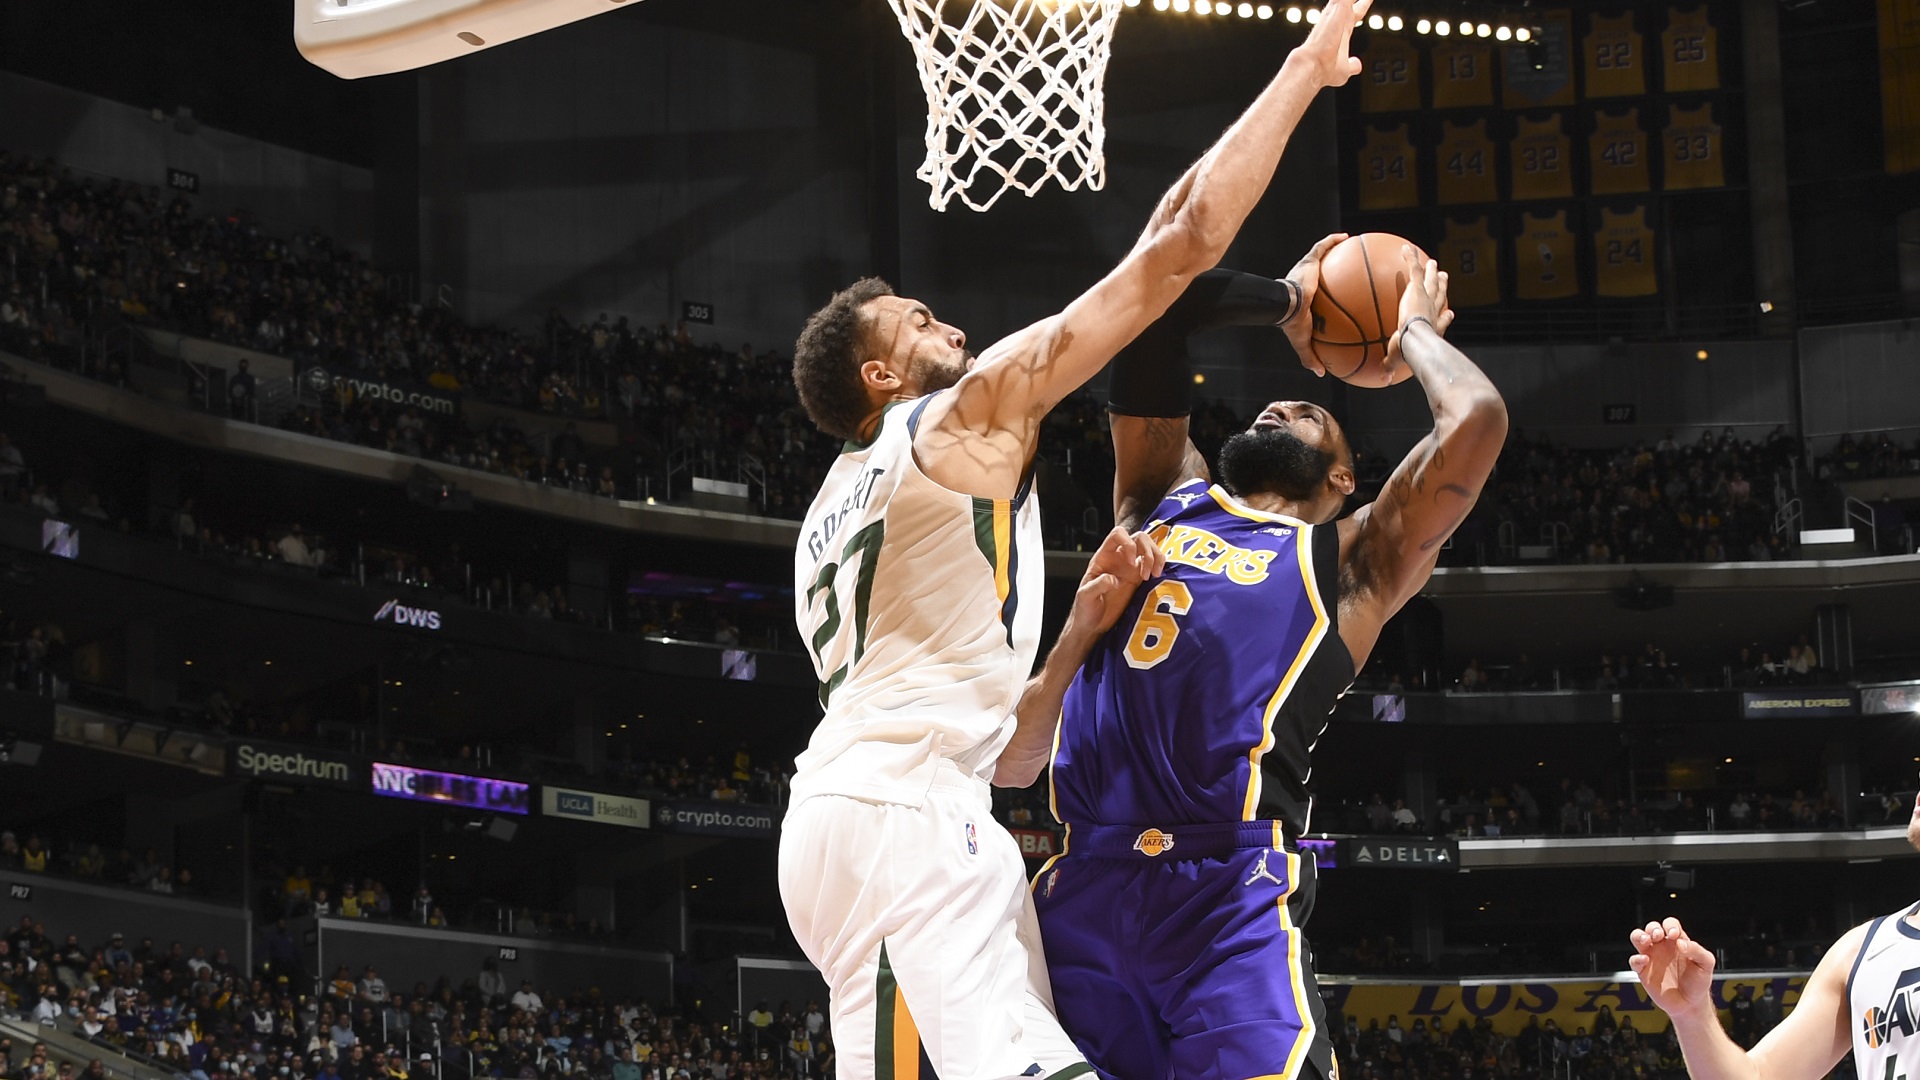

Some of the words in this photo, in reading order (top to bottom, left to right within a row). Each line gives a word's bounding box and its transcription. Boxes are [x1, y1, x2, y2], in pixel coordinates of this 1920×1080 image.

[1597, 43, 1631, 70] 22
[1674, 37, 1706, 64] 25
[1373, 58, 1408, 86] 52
[1450, 55, 1476, 81] 13
[1523, 147, 1559, 173] 32
[1602, 141, 1637, 168] 42
[1675, 135, 1710, 162] 33
[1370, 156, 1406, 182] 34
[1448, 151, 1485, 177] 44
[1460, 249, 1476, 275] 8
[1607, 239, 1643, 265] 24
[688, 305, 708, 319] 305
[1147, 519, 1279, 586] AKERS
[394, 604, 441, 629] DWS
[806, 516, 885, 711] 27
[1122, 579, 1194, 670] 6
[238, 744, 349, 780] Spectrum
[561, 797, 591, 811] UCLA
[597, 801, 638, 818] Health
[676, 811, 771, 829] crypto.com
[1013, 833, 1052, 854] BA
[1379, 846, 1451, 863] DELTA
[1408, 985, 1559, 1017] LOS
